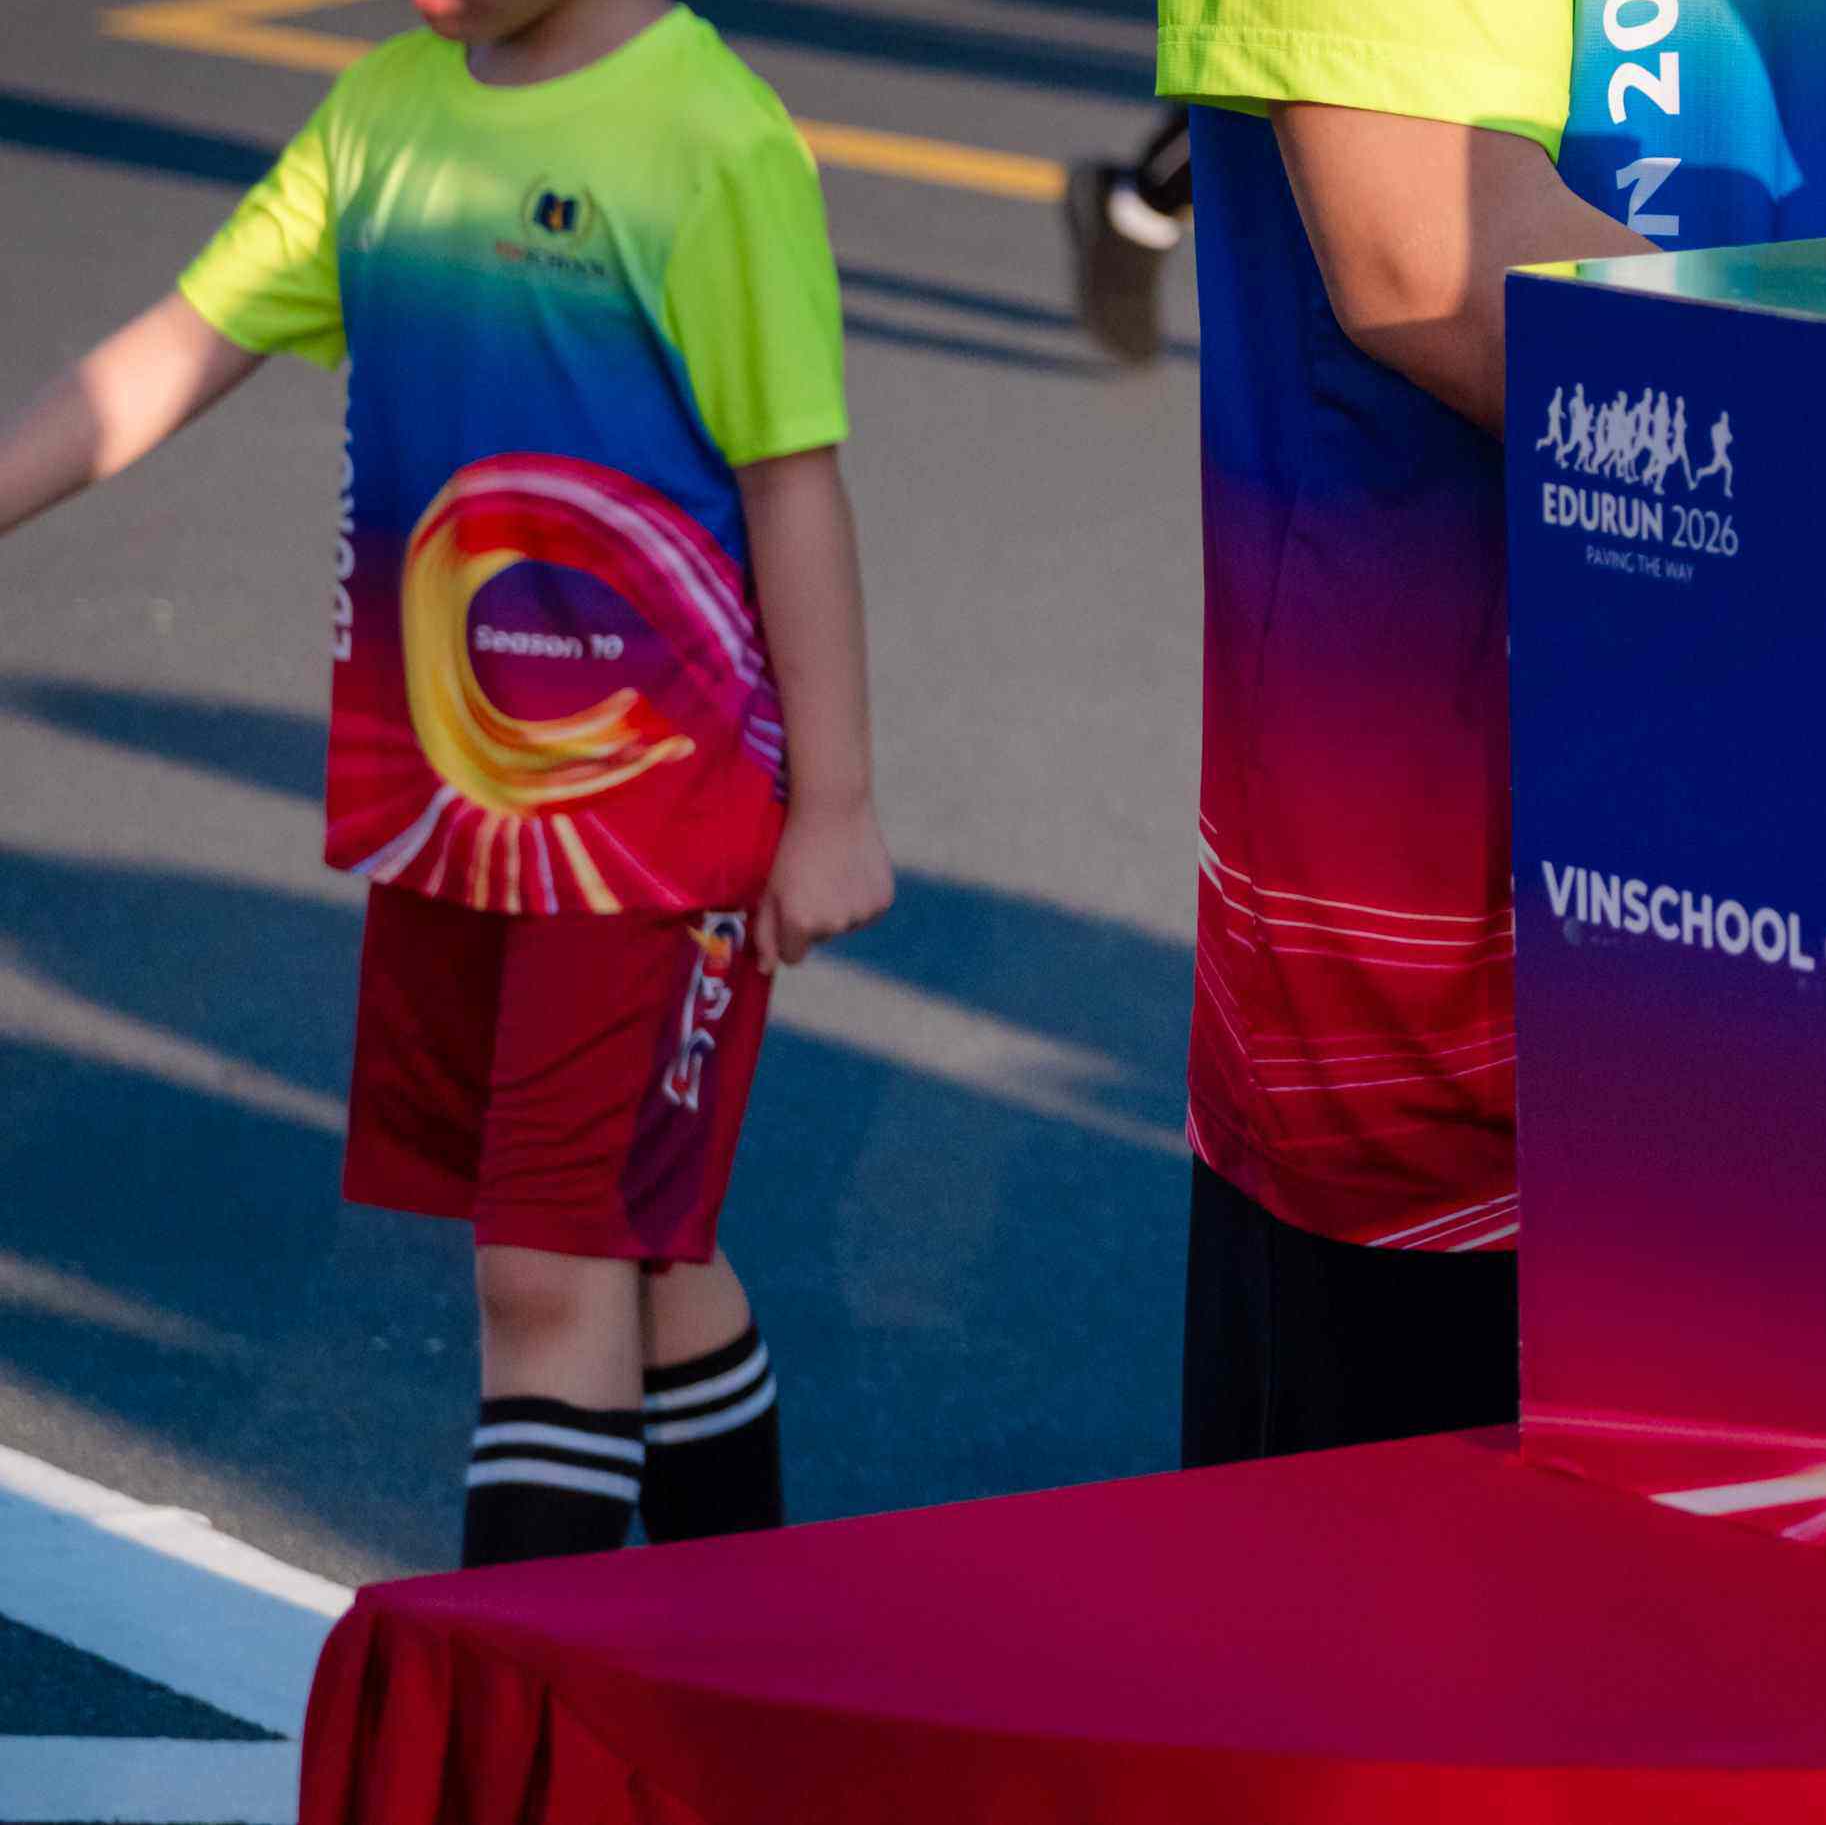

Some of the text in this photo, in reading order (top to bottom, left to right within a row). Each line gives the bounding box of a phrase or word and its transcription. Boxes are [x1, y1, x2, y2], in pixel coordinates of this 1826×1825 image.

[1542, 482, 1739, 557] EDURUN 2026
[1586, 544, 1695, 582] PAVING THE WAY
[475, 624, 624, 661] Season 10
[1541, 860, 1815, 971] VINSCHOOL
